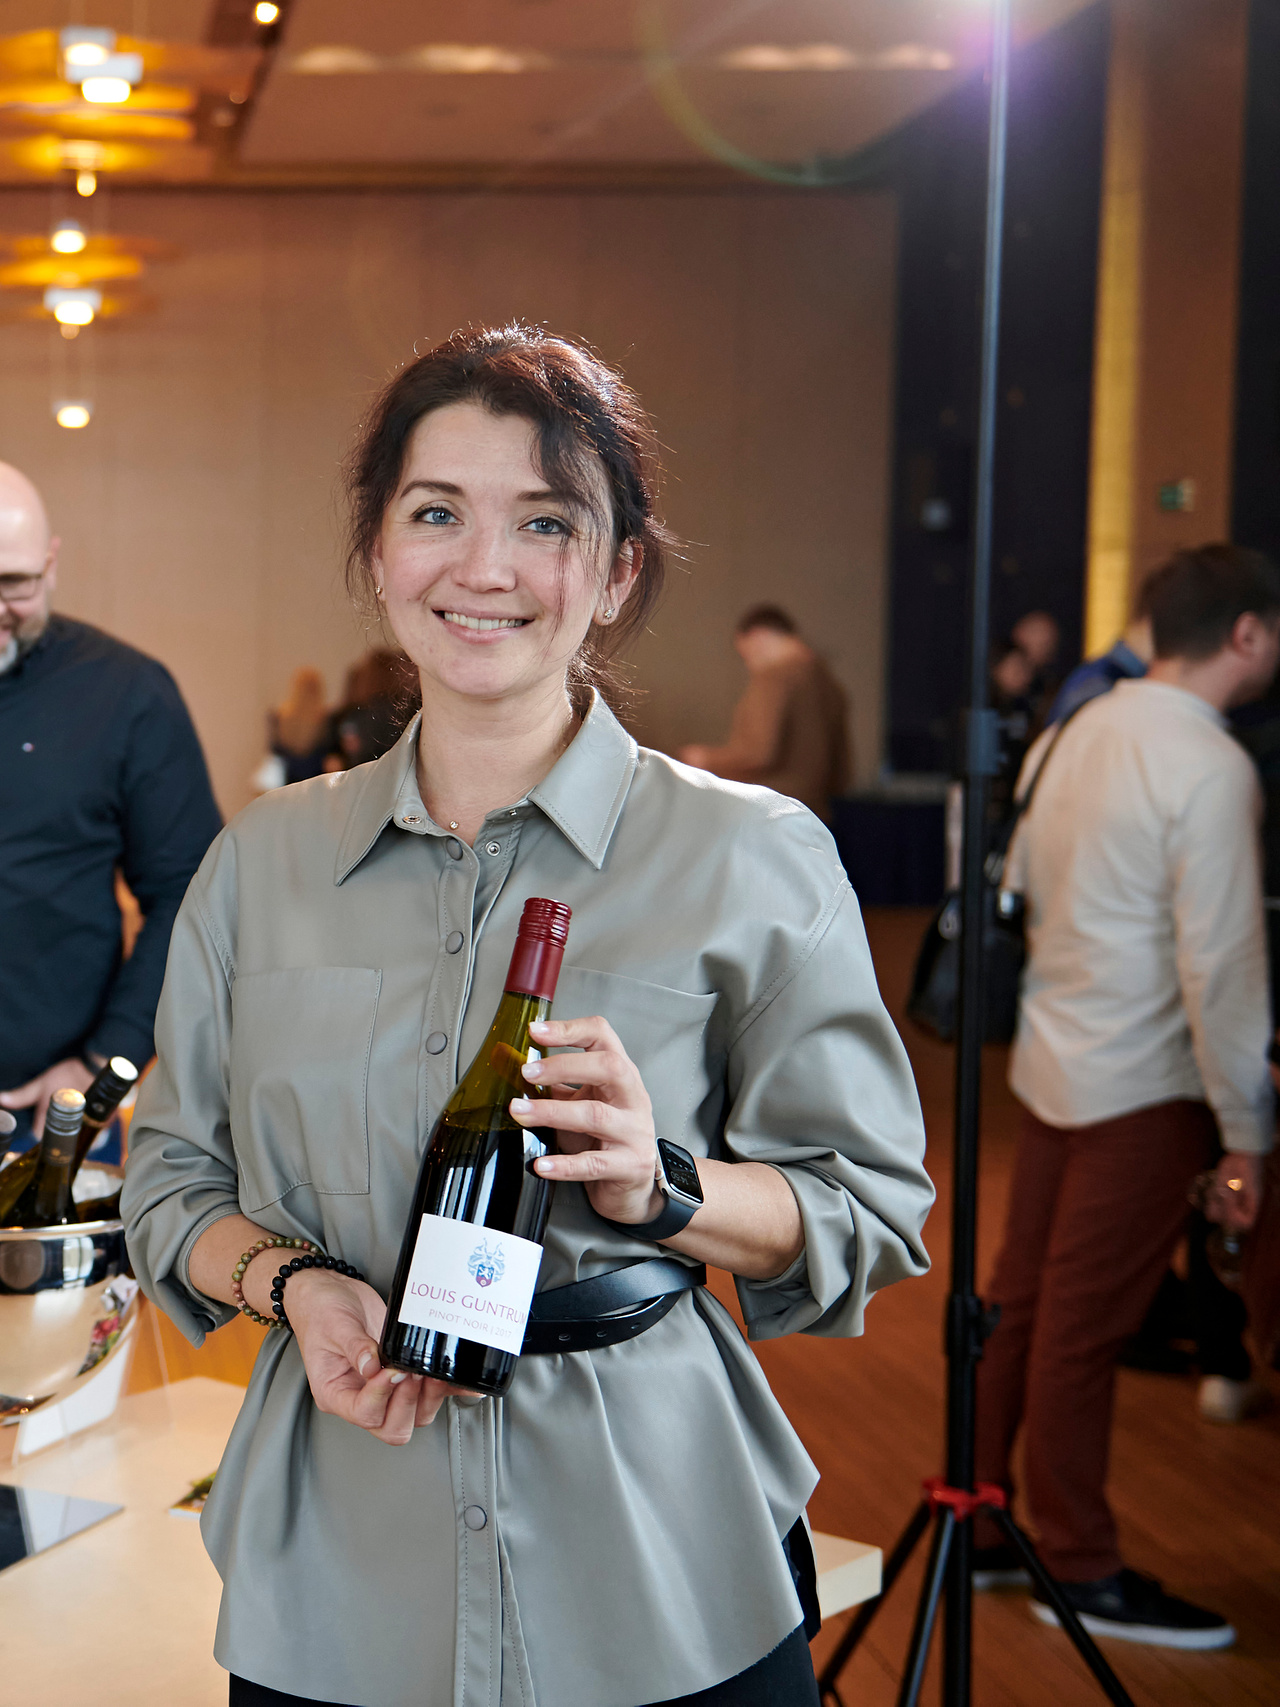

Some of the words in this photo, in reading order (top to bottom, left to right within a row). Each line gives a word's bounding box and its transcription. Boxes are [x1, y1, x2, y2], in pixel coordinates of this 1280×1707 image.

[410, 1281, 457, 1304] LOUIS
[428, 1308, 461, 1323] PINOT
[463, 1318, 489, 1332] NOIR
[495, 1327, 512, 1338] 2017
